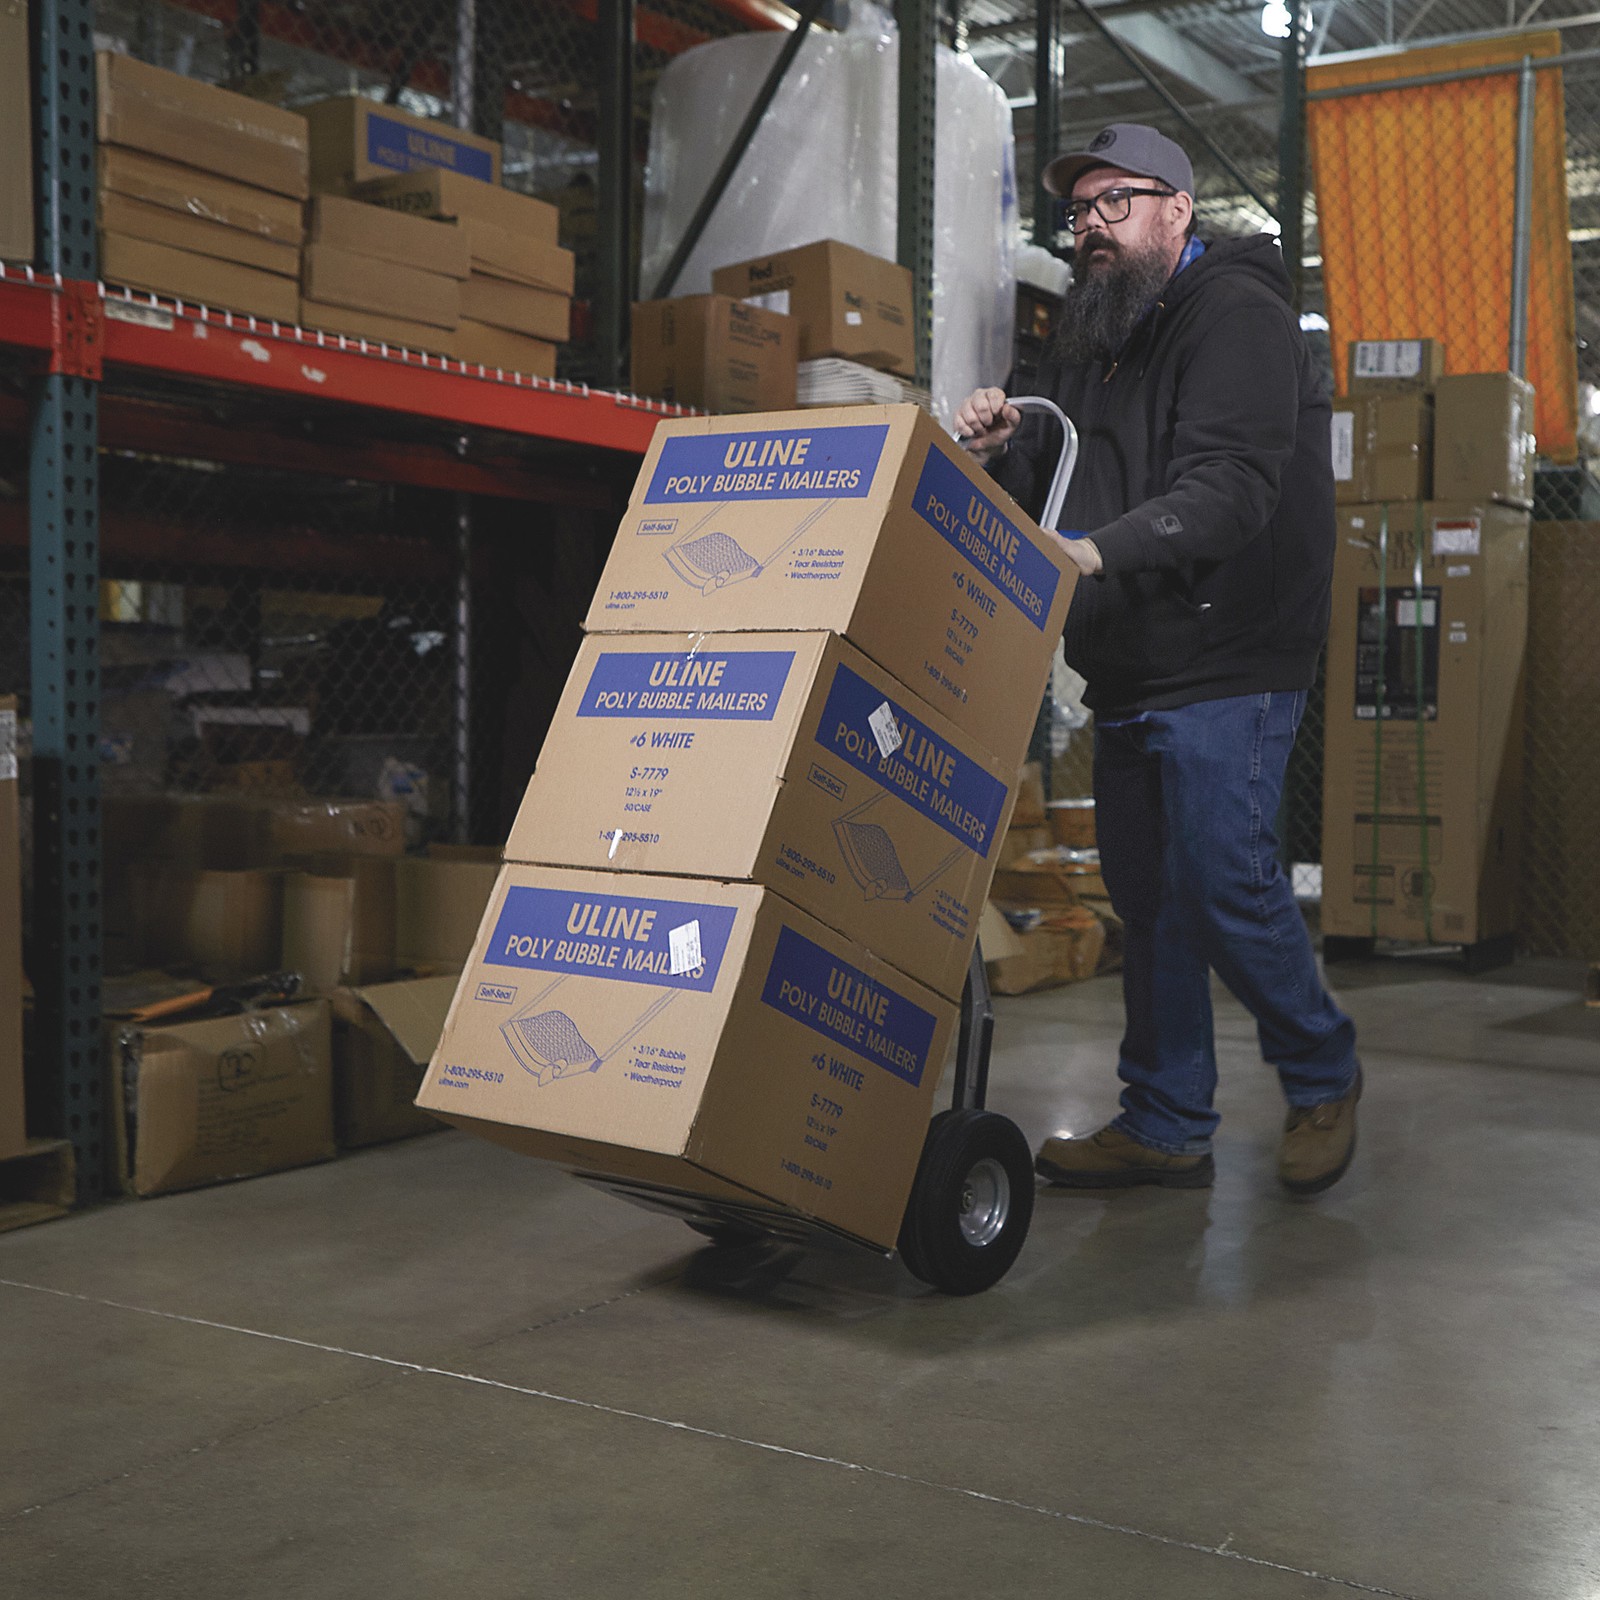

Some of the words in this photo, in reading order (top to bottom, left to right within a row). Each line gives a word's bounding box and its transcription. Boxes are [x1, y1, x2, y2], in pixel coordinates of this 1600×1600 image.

[723, 438, 811, 468] ULINE
[664, 475, 712, 495] POLY
[712, 472, 776, 493] BUBBLE
[779, 469, 861, 490] MAILERS
[642, 523, 673, 531] Self-Seal
[966, 495, 1021, 565] ULINE
[794, 560, 810, 568] Tear
[811, 560, 844, 568] Resistant
[818, 548, 844, 557] Bubble
[926, 494, 959, 535] POLY
[959, 523, 999, 574] BUBBLE
[998, 563, 1044, 617] MAILERS
[790, 572, 841, 580] Weatherproof
[609, 591, 669, 600] 1-800-295-5510
[966, 579, 997, 619] WHITE
[950, 608, 979, 639] S-7779
[649, 660, 727, 687] ULINE
[595, 692, 638, 709] POLY
[638, 692, 694, 710] BUBBLE
[696, 693, 768, 711] MAILERS
[651, 732, 695, 748] WHITE
[630, 767, 669, 780] S-7779
[813, 770, 842, 794] Self-Seal
[835, 722, 877, 764] POLY
[877, 757, 929, 801] BUBBLE
[930, 791, 987, 843] MAILERS
[599, 830, 660, 844] 1-80-295-5510
[780, 843, 836, 884] 1-800-295-5510
[566, 902, 657, 942] ULINE
[504, 934, 553, 959] POLY
[554, 941, 620, 968] BUBBLE
[622, 949, 707, 979] MAILS
[480, 987, 512, 999] Self-Seal
[827, 967, 889, 1027] ULINE
[779, 979, 818, 1016] POLY
[818, 1003, 865, 1044] BUBBLE
[865, 1029, 917, 1074] MAILERS
[634, 1058, 650, 1069] Tear
[652, 1061, 686, 1075] Resistant
[659, 1048, 686, 1061] Bubble
[438, 1078, 469, 1088] uline.com
[444, 1064, 504, 1083] 1-800-295-5510
[630, 1072, 682, 1088] Weatherproof
[829, 1058, 865, 1092] WHITE
[811, 1093, 843, 1119] S-7779
